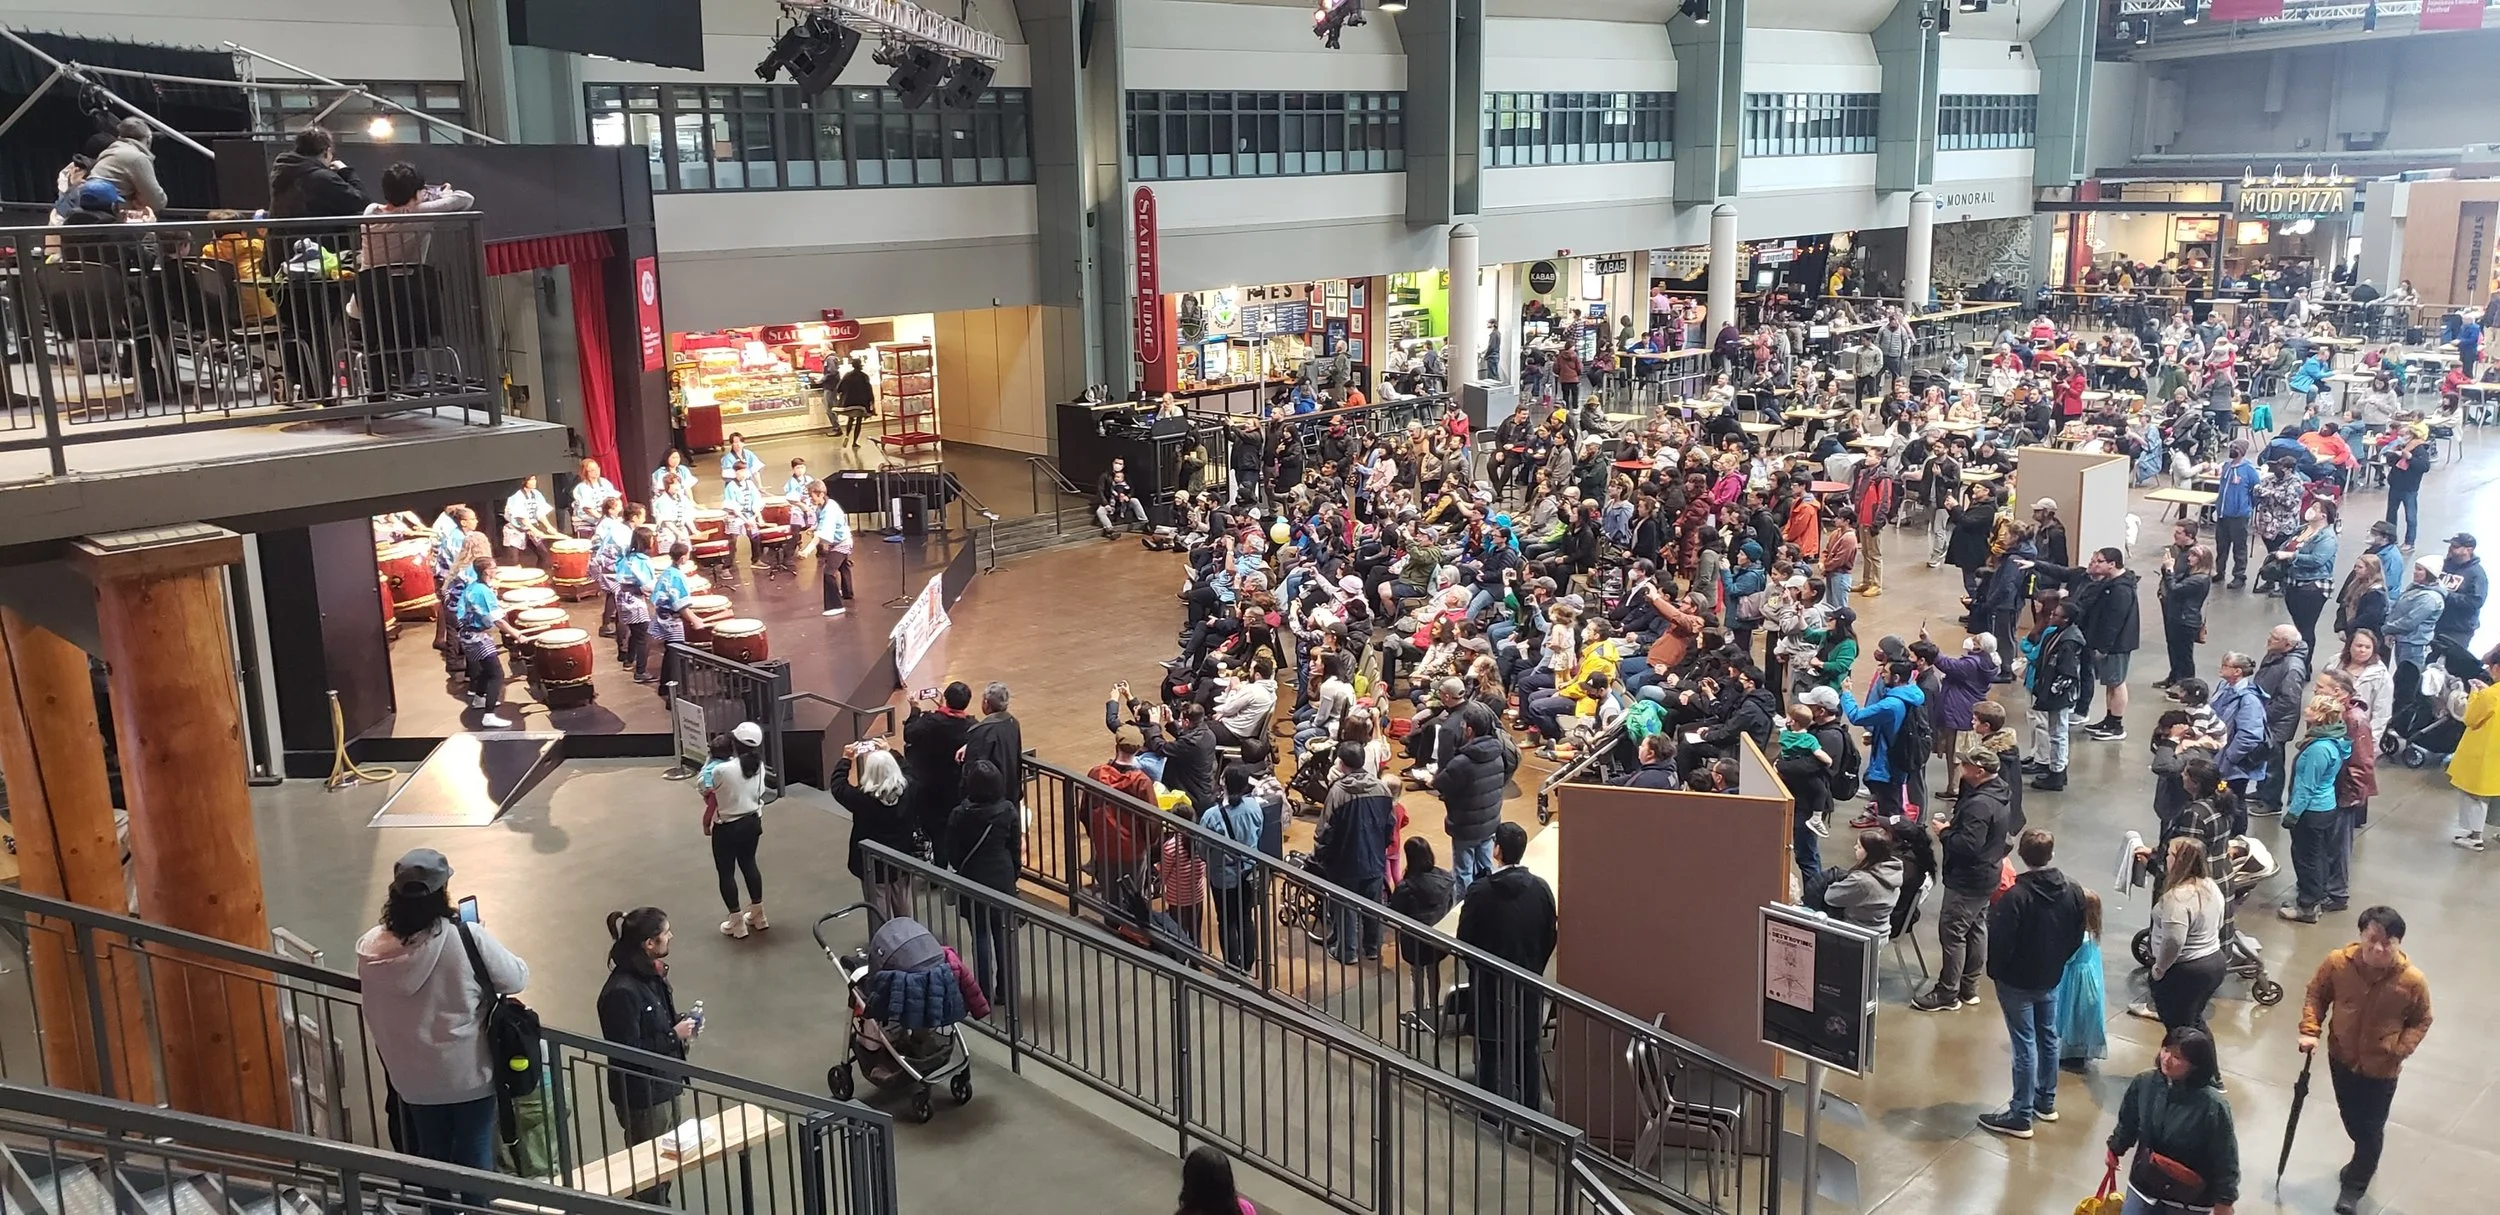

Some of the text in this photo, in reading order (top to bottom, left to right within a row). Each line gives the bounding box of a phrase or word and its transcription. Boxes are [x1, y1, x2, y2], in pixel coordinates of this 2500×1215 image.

[1947, 191, 1995, 206] MONORAIL
[2240, 191, 2343, 213] MOD PIZZA
[2467, 215, 2484, 291] STARBUCKS
[1139, 198, 1154, 348] SEATTLE FUDGE
[1531, 273, 1556, 281] KABAB
[1596, 261, 1626, 275] KABAB
